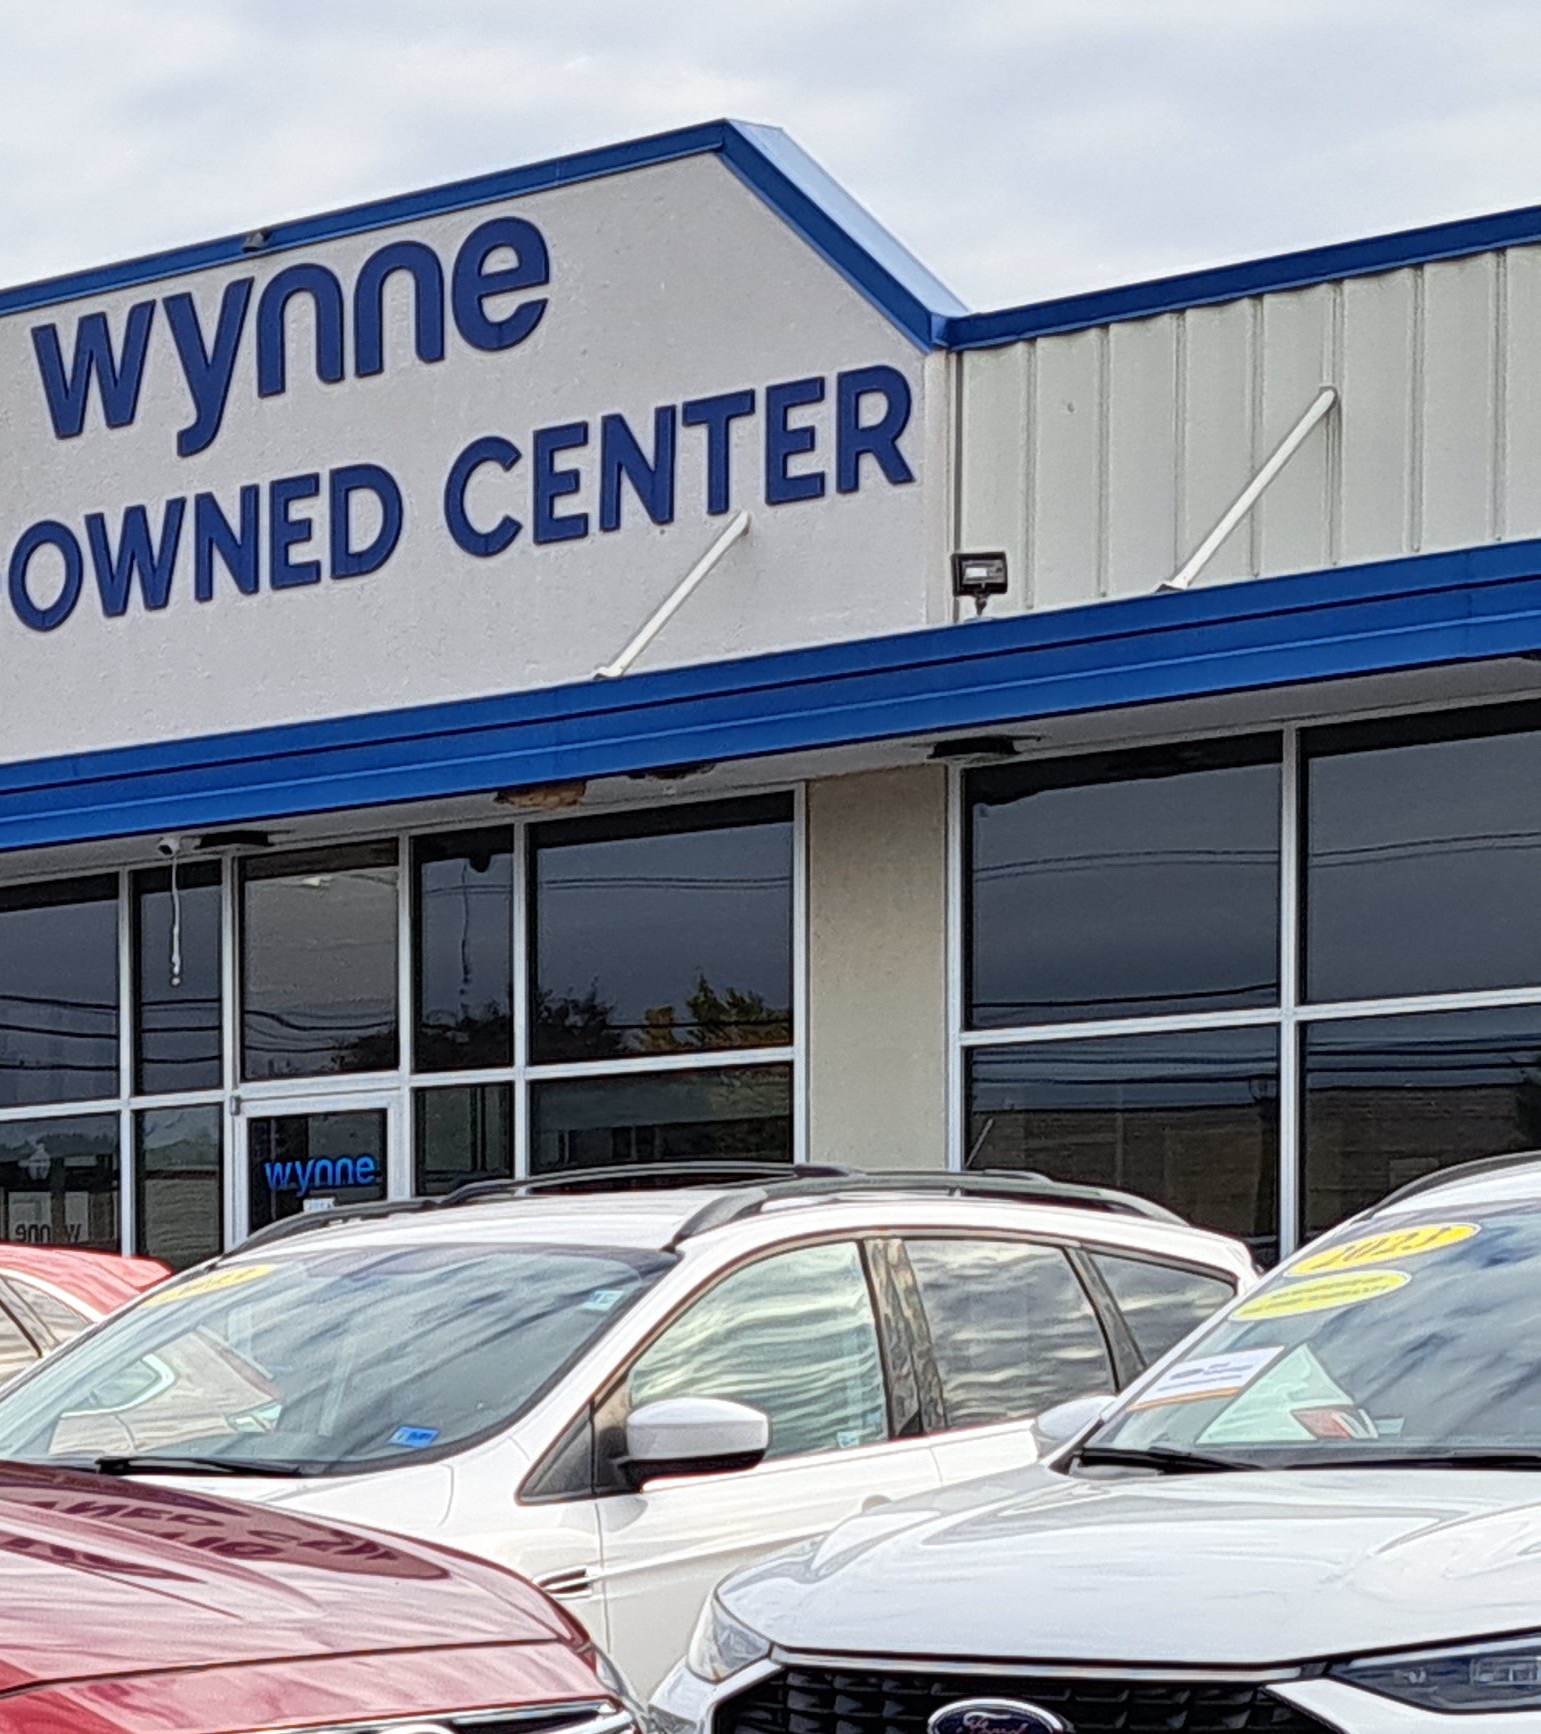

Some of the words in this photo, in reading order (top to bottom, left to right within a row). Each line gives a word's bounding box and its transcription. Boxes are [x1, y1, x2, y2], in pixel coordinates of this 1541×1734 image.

[30, 215, 551, 458] wynne
[444, 363, 916, 557] CENTER
[264, 1154, 377, 1198] wynne
